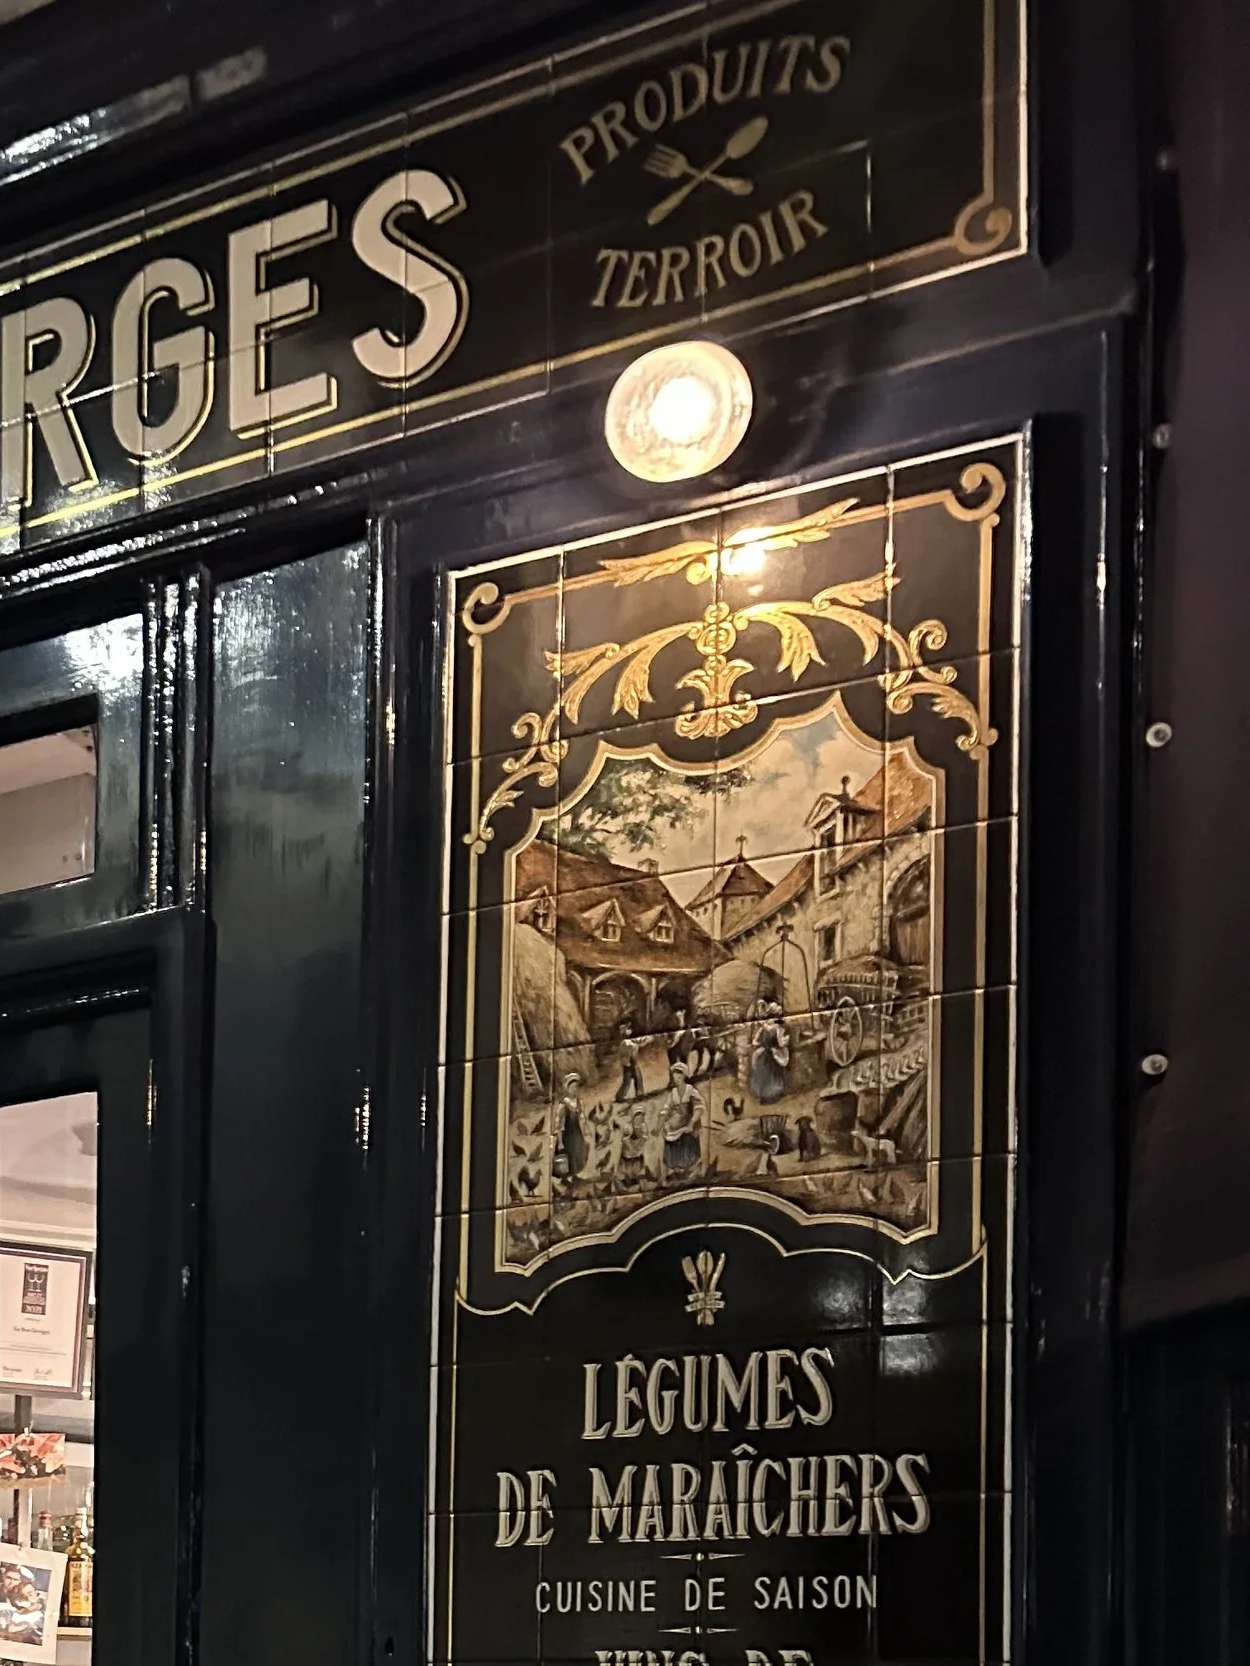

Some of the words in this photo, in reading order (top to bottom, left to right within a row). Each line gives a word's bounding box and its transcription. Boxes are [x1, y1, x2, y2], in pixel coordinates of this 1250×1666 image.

[559, 33, 850, 187] PRODUITS
[590, 189, 829, 309] TERROIR
[580, 1346, 835, 1440] LÉGUMES
[494, 1467, 558, 1548] DE
[586, 1443, 932, 1544] MARAÎCHERS
[535, 1578, 656, 1613] CUISINE
[684, 1576, 725, 1611] DE
[754, 1574, 877, 1609] SAISON
